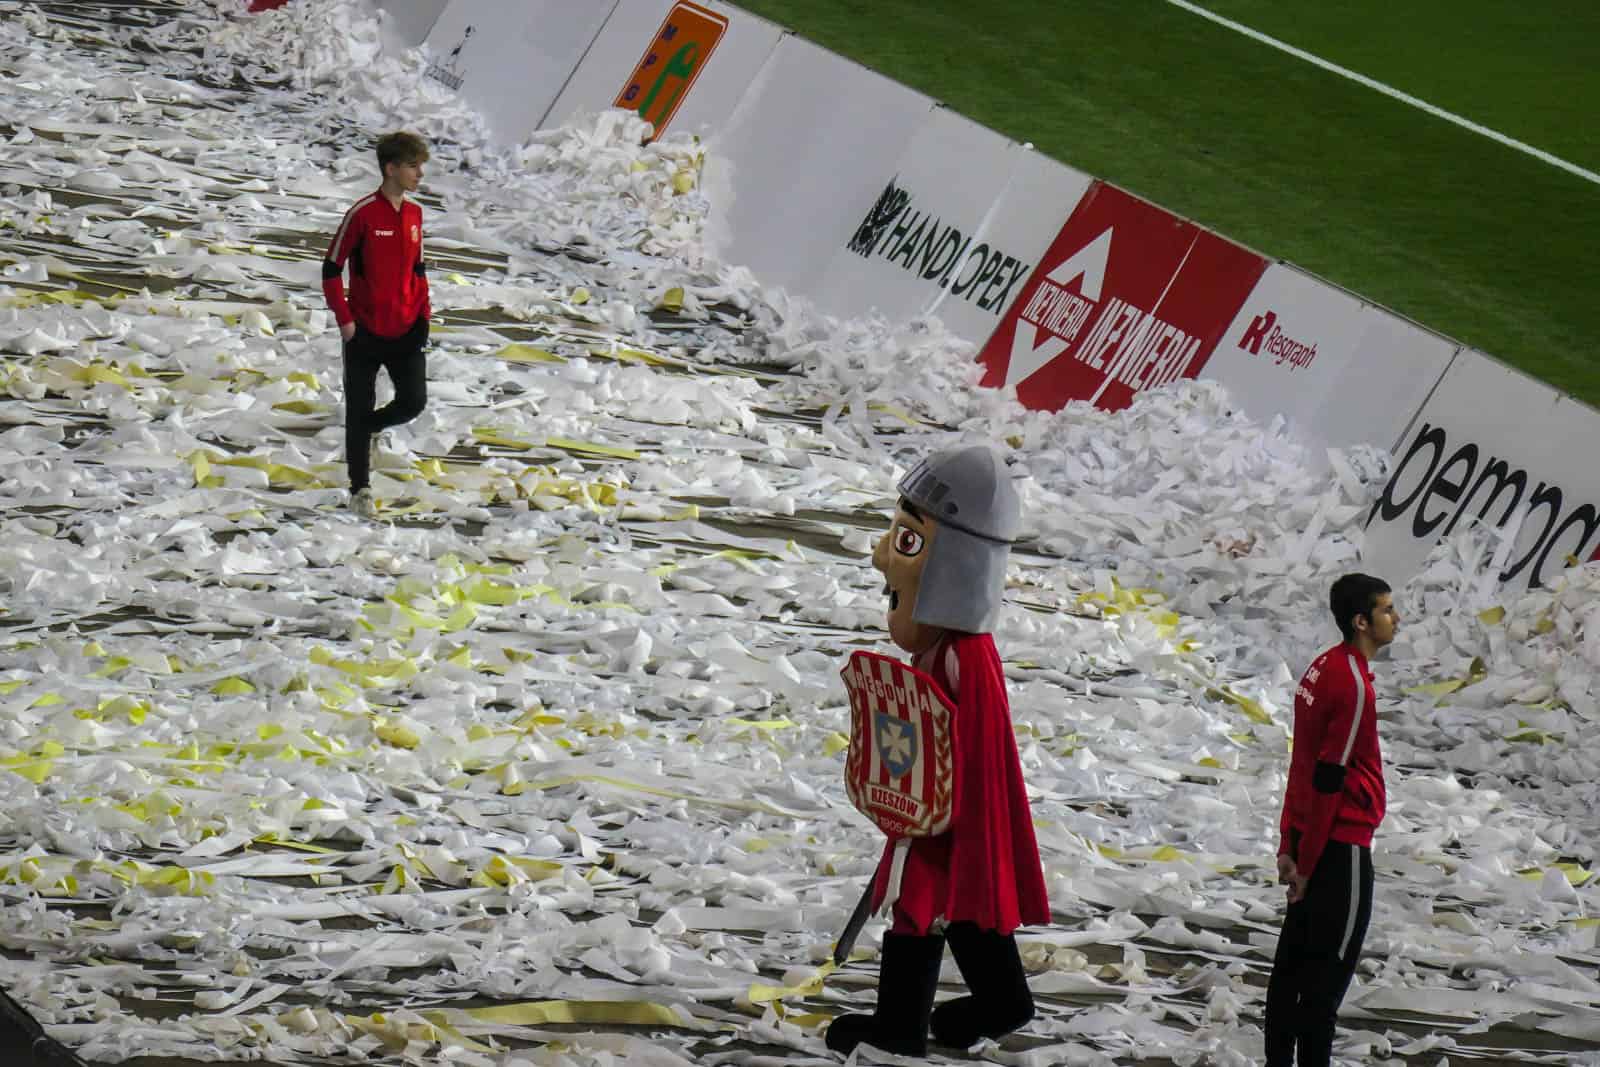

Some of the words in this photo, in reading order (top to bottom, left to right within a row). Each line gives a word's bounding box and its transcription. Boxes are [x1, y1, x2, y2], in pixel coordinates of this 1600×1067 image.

[878, 206, 1029, 315] HANDLOPEX
[1263, 324, 1318, 372] Resgraph
[871, 786, 919, 817] RZESZÓW
